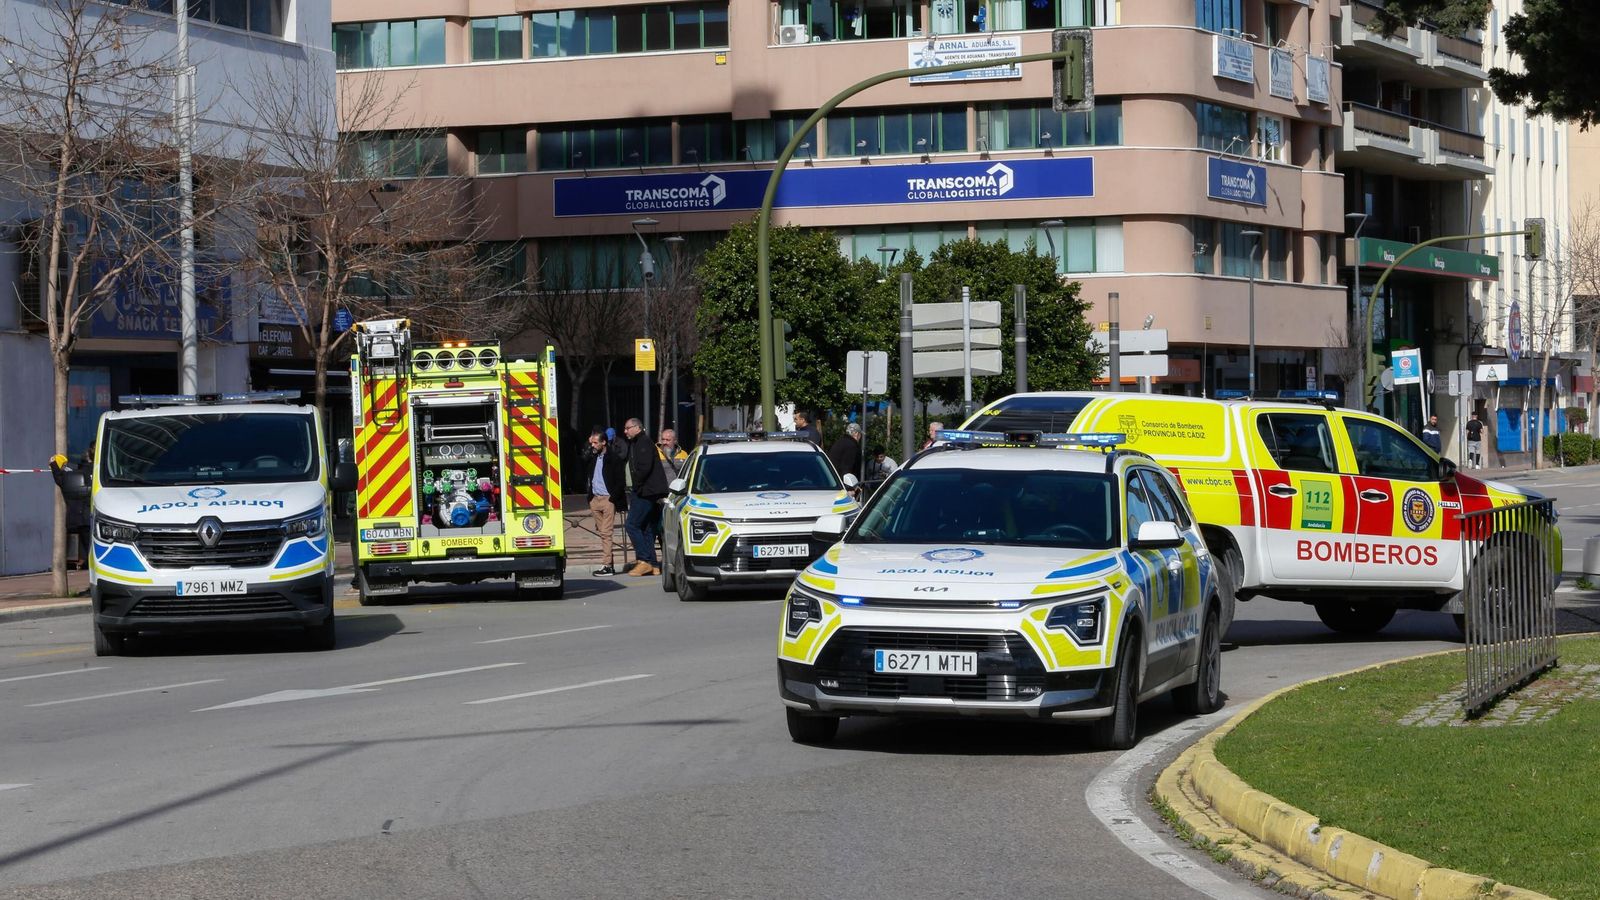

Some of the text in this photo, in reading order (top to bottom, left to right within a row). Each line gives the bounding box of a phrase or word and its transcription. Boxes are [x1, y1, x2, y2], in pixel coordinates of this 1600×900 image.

[939, 41, 968, 50] ARNAL
[907, 176, 997, 190] TRANSCOMA
[1220, 174, 1251, 190] TRANSCOMA
[625, 187, 710, 201] TRANSCOMA
[117, 315, 159, 332] SNACK
[411, 380, 433, 389] P-52
[1141, 420, 1169, 429] Consorcio
[1176, 422, 1203, 430] Bomberos
[1143, 429, 1177, 438] PROVINCIA
[1177, 431, 1186, 439] DE
[1185, 477, 1233, 487] www.cbpc.es
[1306, 490, 1330, 504] 112
[366, 528, 412, 538] 6040 MBN
[441, 537, 484, 547] BOMBEROS
[760, 545, 807, 556] 6279 MTH
[1297, 540, 1438, 566] BOMBEROS
[185, 580, 244, 593] 7961 MMZ
[888, 653, 930, 671] 6271
[938, 654, 972, 672] MTH
